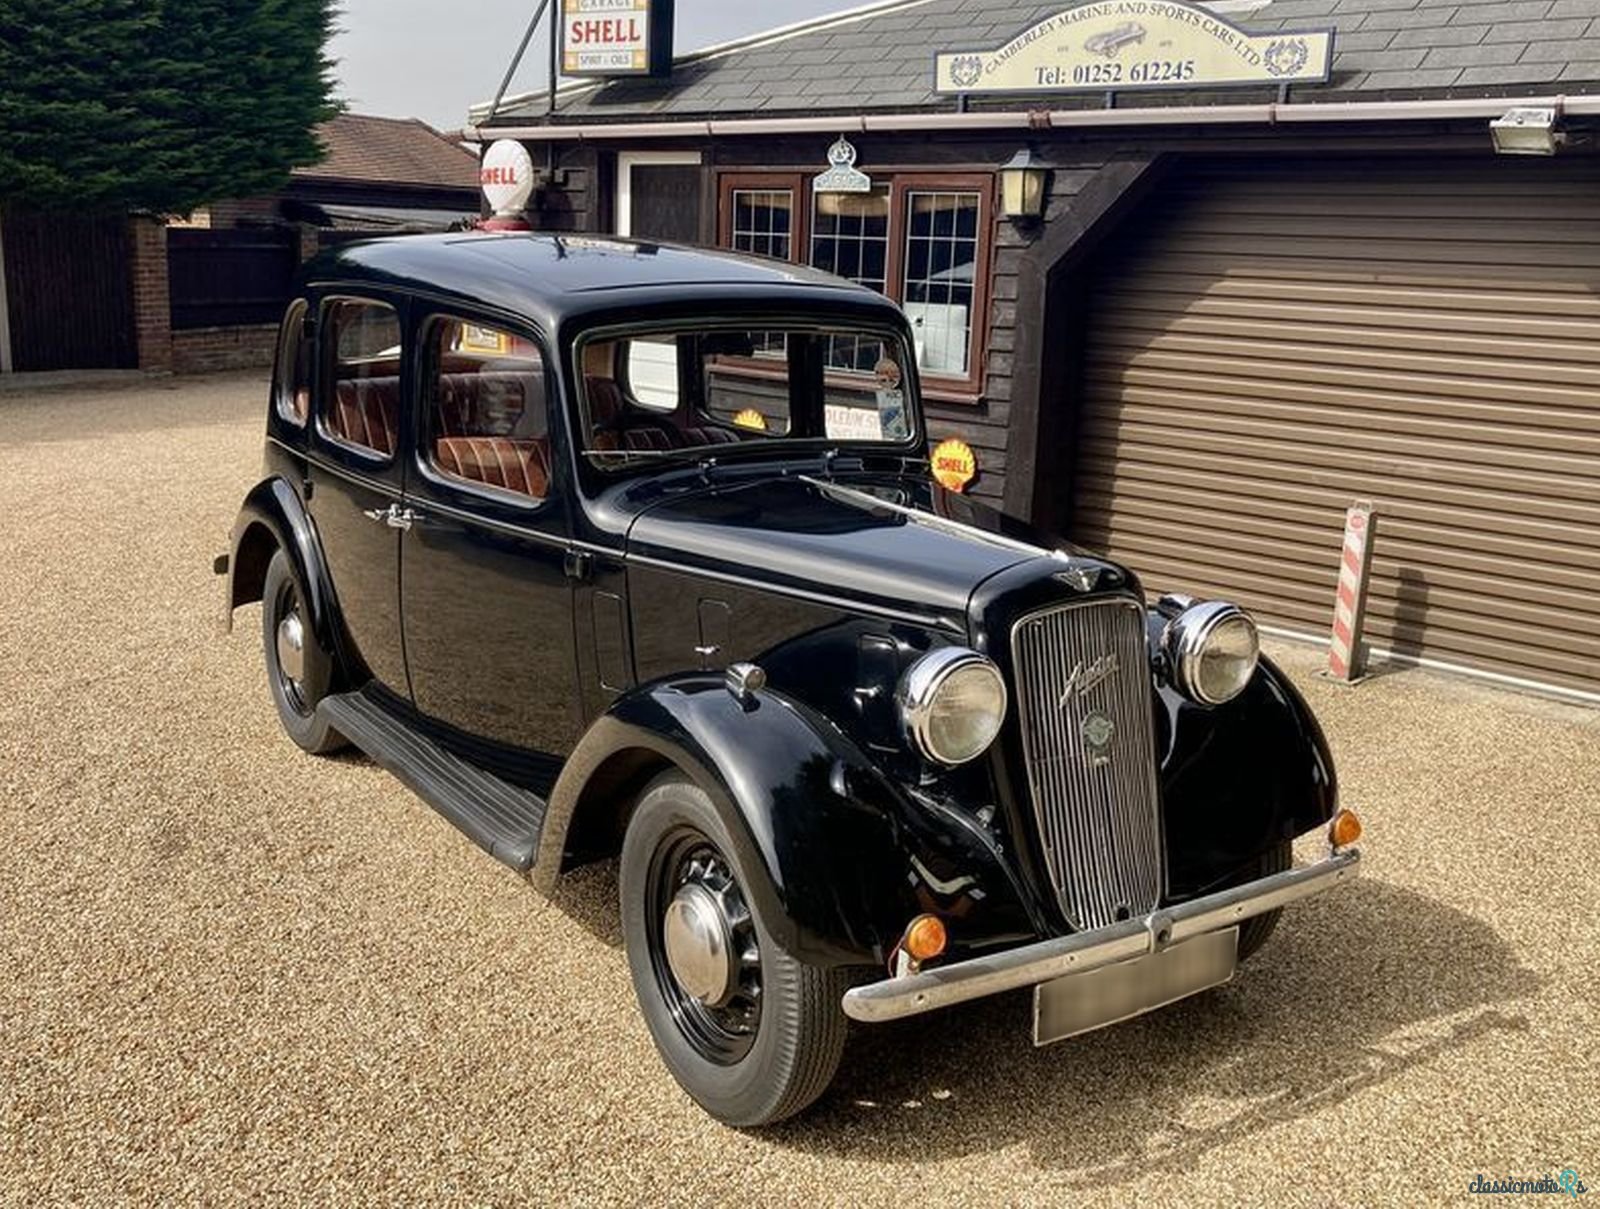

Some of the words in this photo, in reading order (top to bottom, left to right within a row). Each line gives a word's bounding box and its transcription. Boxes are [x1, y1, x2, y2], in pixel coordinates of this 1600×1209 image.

[571, 18, 641, 43] SHELL
[985, 21, 1056, 74] CAMBERLEY
[1058, 3, 1113, 26] MARINE
[1115, 2, 1147, 14] AND
[1148, 4, 1200, 26] SPORTS
[1201, 19, 1236, 45] CARS
[1234, 39, 1261, 66] LTD
[1035, 65, 1066, 84] Tel:
[1073, 63, 1122, 83] 01252
[1130, 60, 1194, 81] 612245
[937, 457, 969, 474] SHELL
